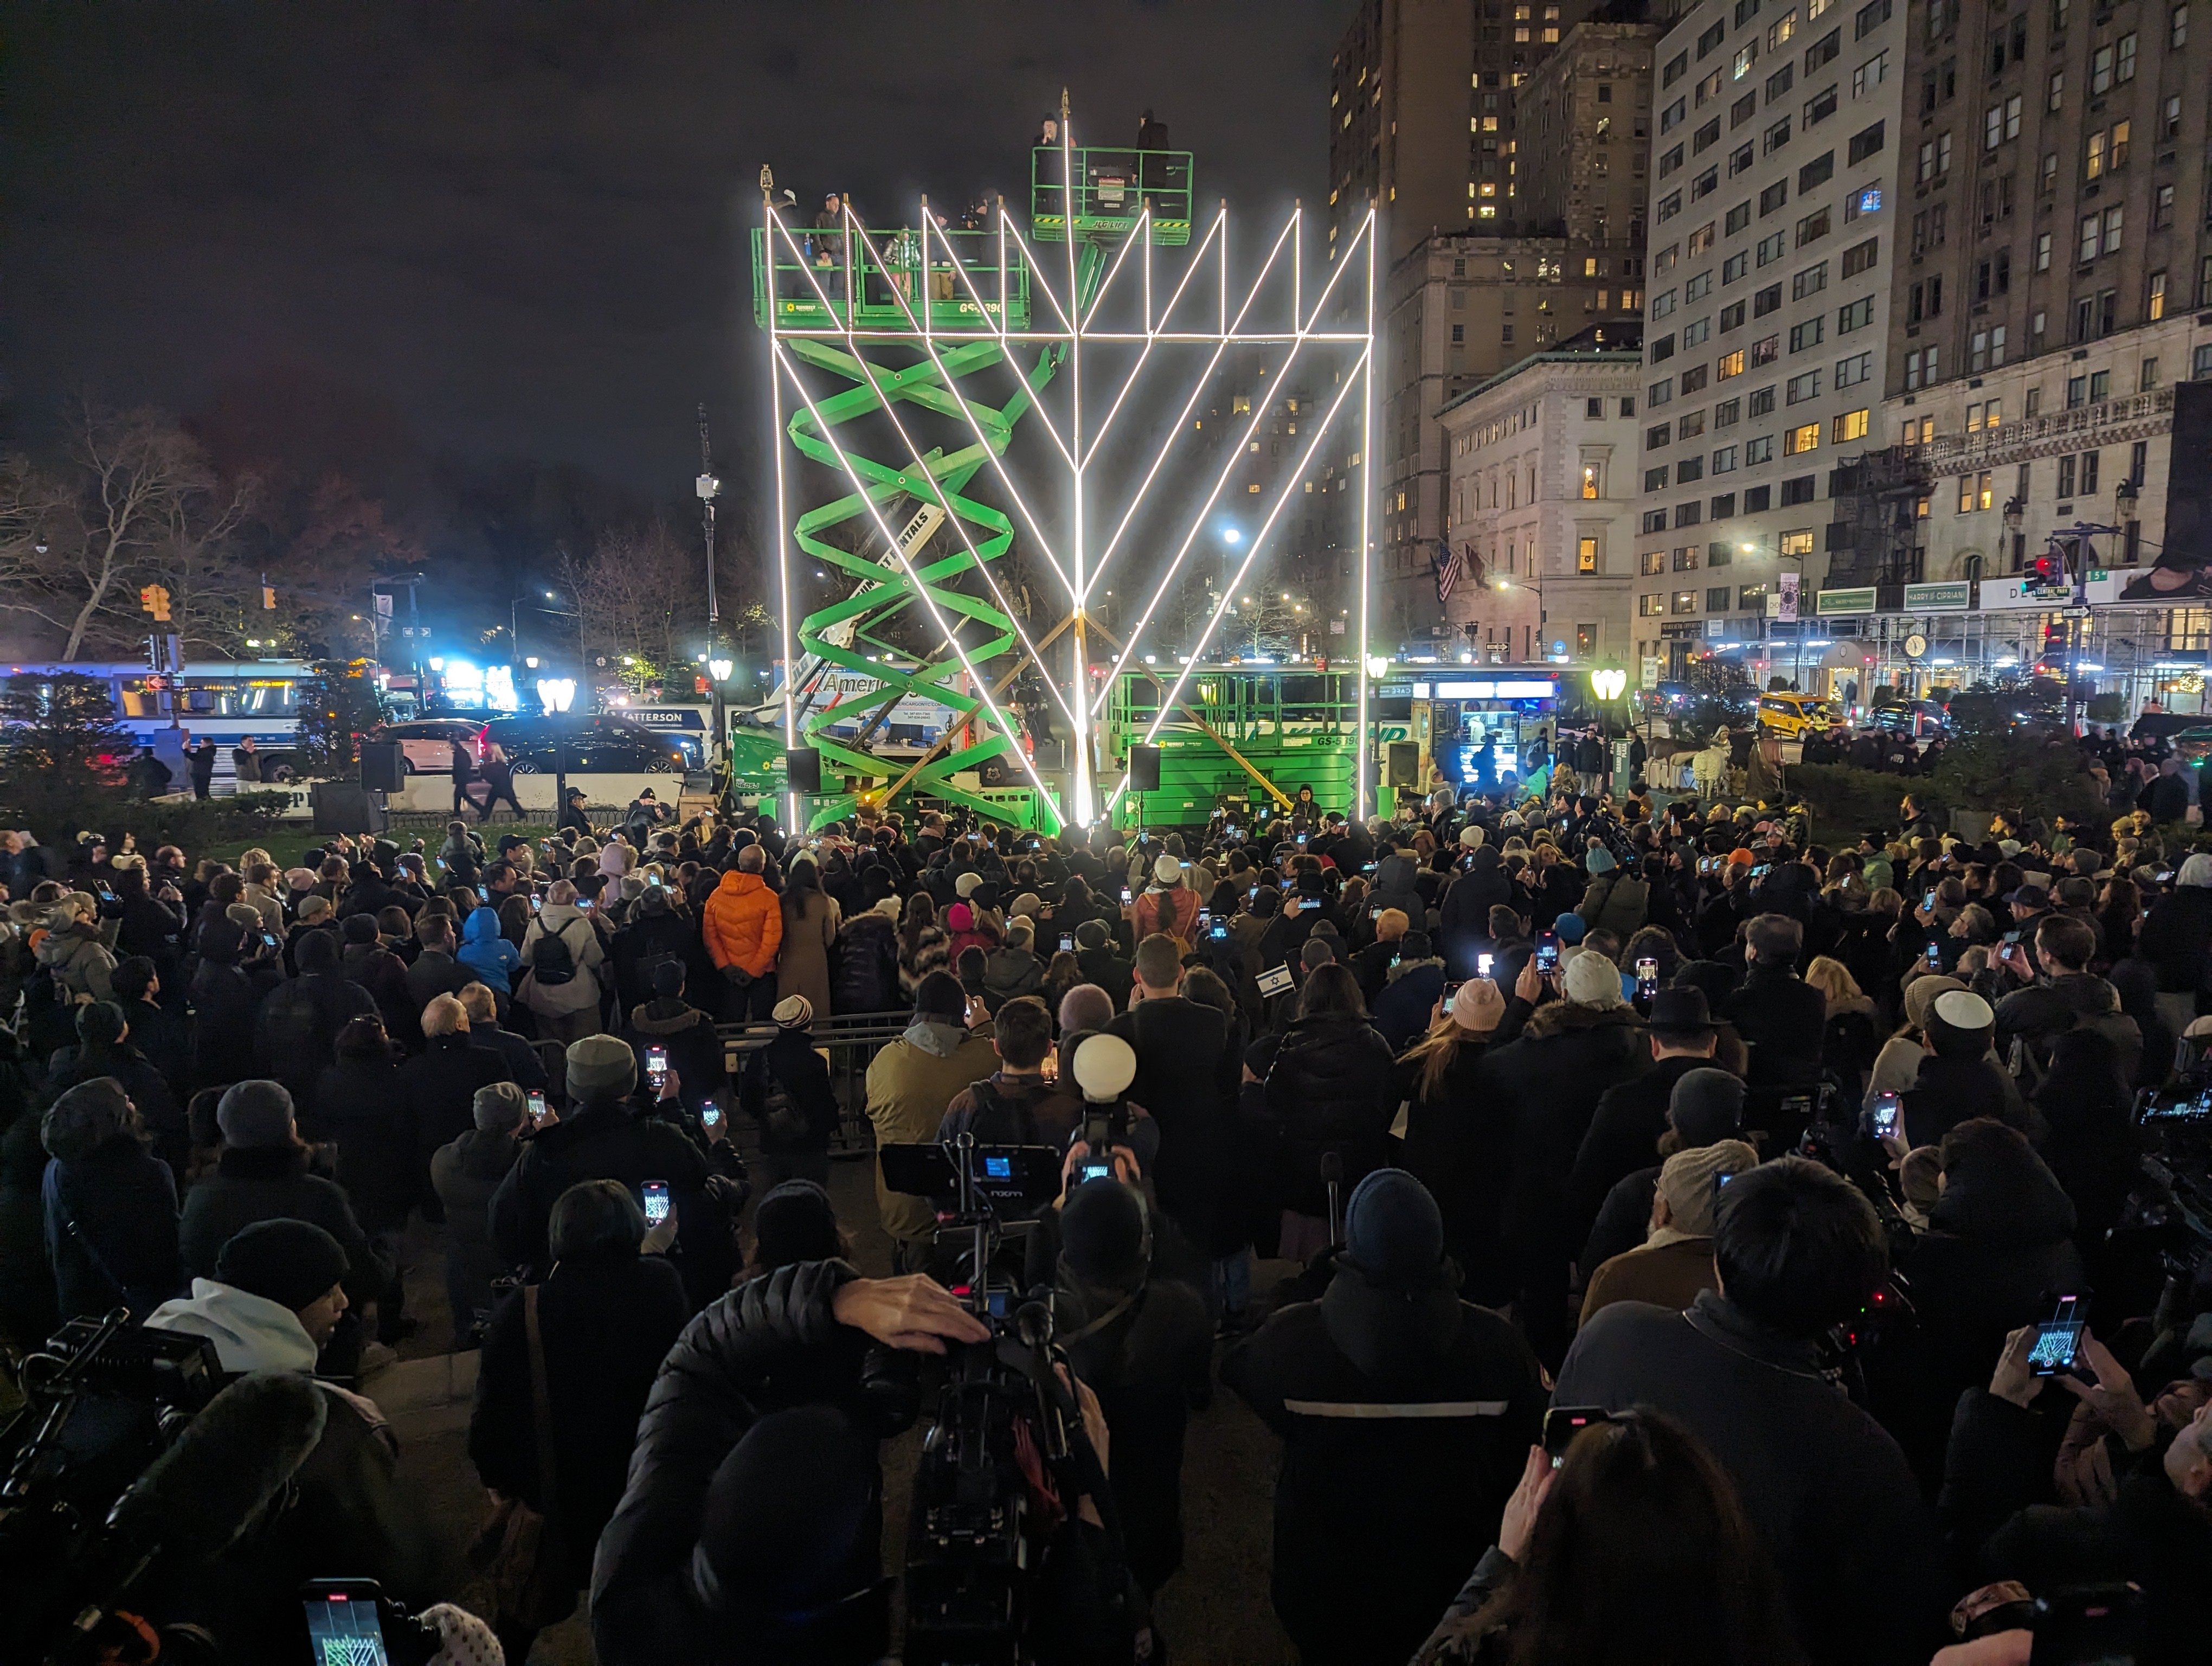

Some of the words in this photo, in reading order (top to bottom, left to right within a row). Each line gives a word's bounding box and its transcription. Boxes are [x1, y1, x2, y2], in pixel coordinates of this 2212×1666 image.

[959, 303, 1001, 313] GS-390
[2094, 572, 2100, 580] 5
[1937, 591, 1965, 600] CIPRIANI
